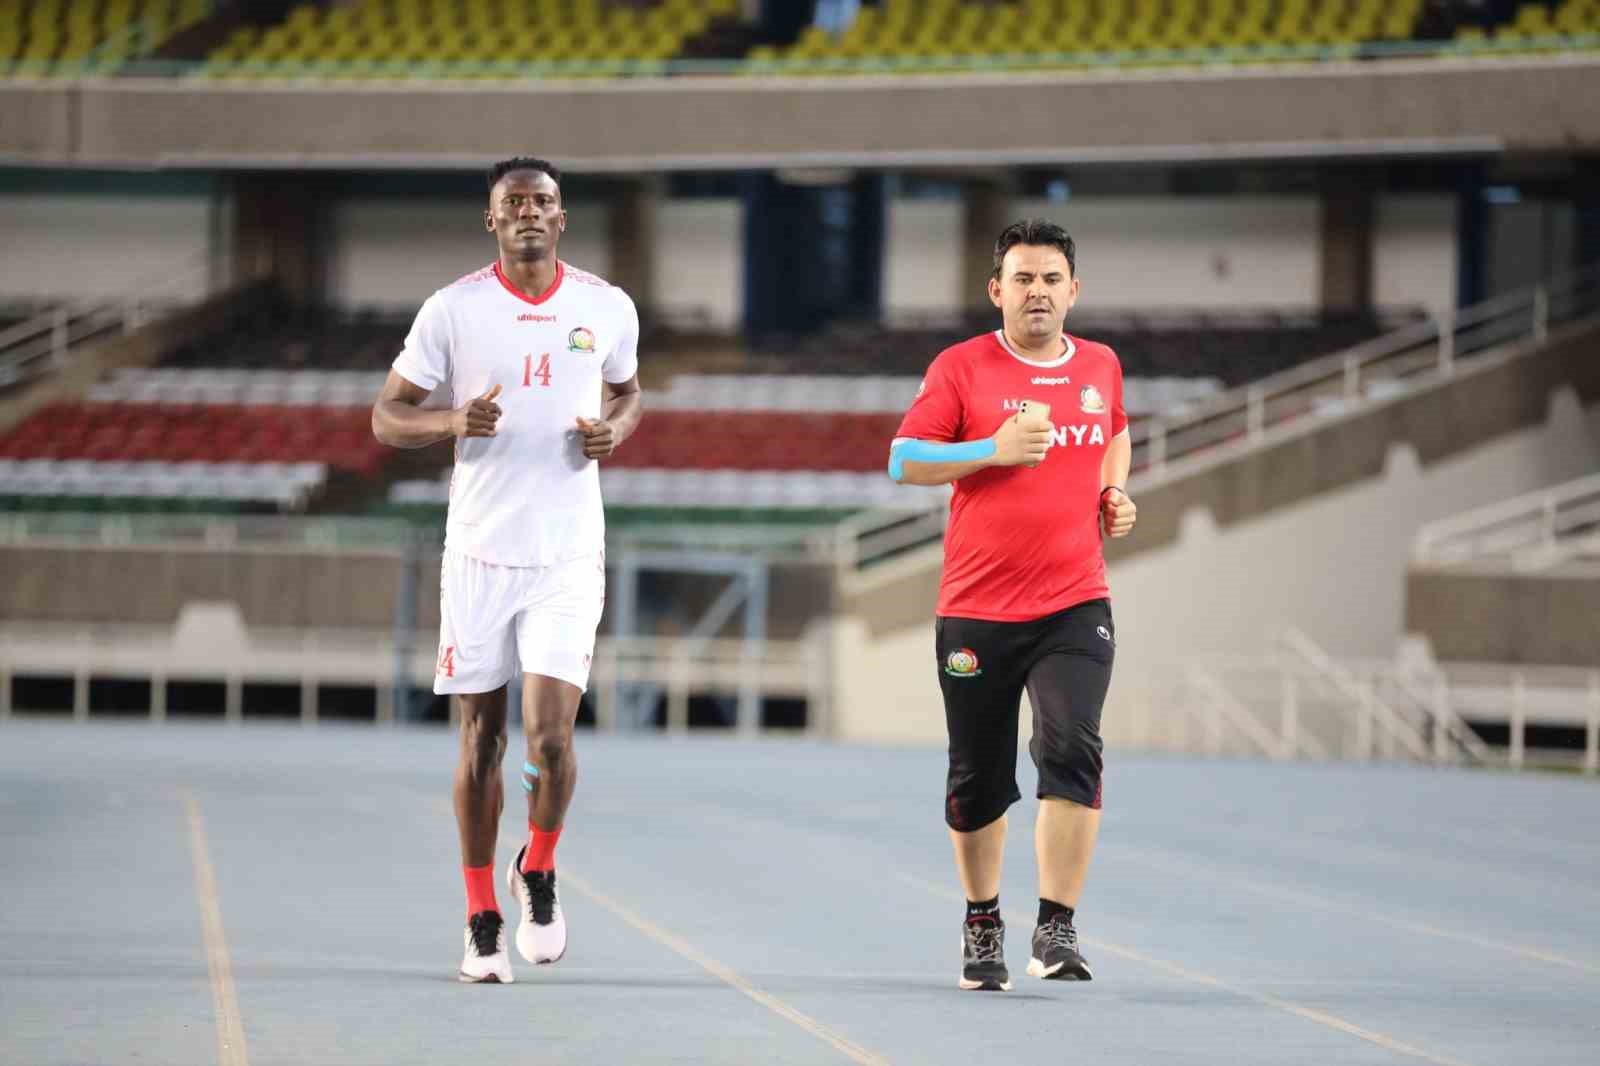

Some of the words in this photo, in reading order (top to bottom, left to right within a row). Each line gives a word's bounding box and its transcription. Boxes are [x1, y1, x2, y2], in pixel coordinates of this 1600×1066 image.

[517, 313, 557, 322] uhlsport
[522, 352, 552, 386] 14
[1031, 376, 1070, 386] uhlsport
[1049, 424, 1104, 446] NYA
